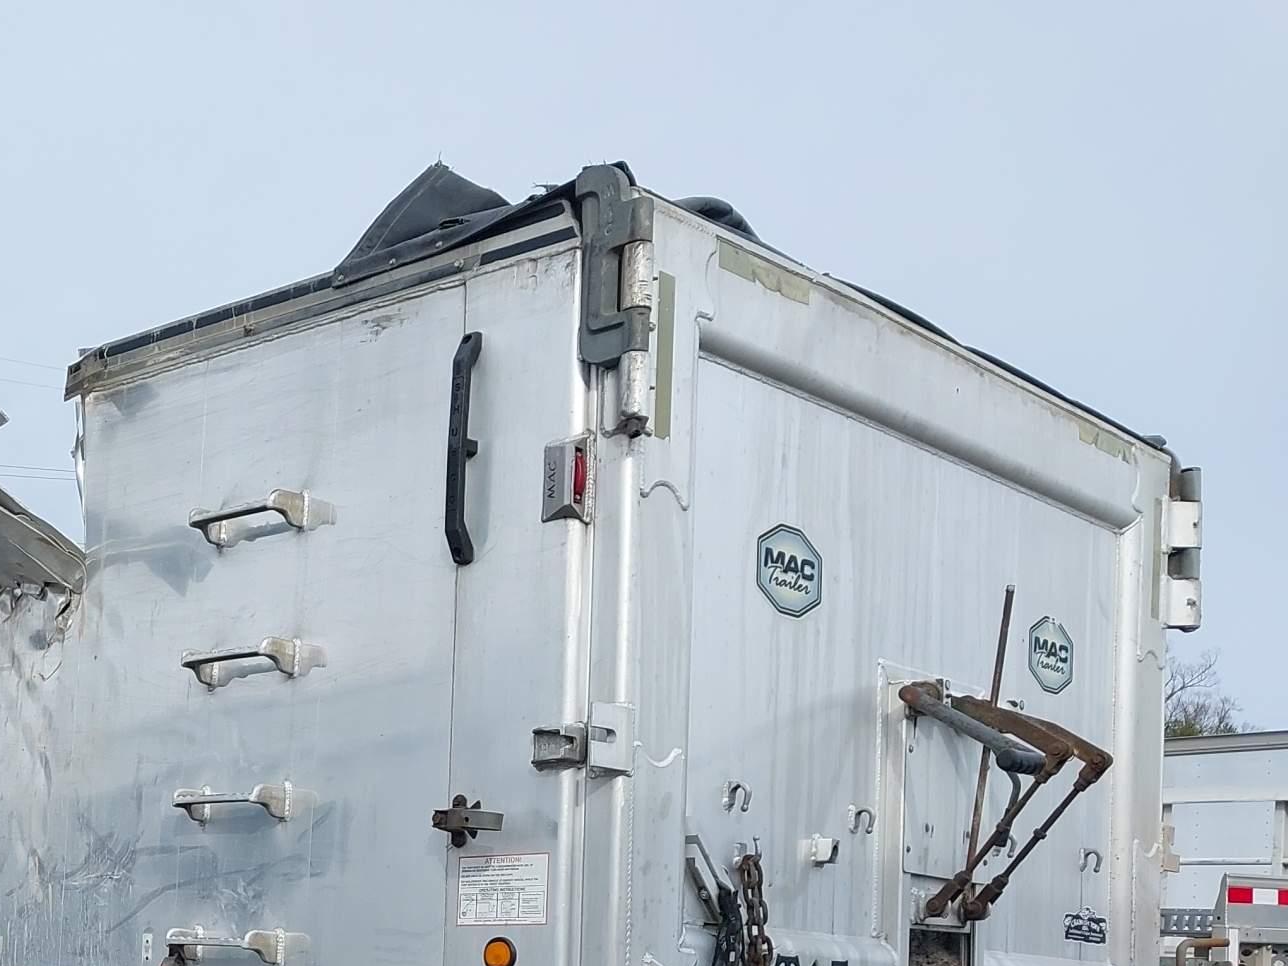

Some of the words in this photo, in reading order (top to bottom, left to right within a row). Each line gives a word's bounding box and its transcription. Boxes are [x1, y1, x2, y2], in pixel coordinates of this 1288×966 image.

[546, 460, 557, 499] MAC
[763, 546, 815, 582] MAC
[767, 564, 812, 595] Trailer
[1033, 635, 1069, 664] MAC
[1036, 651, 1066, 675] Trailer
